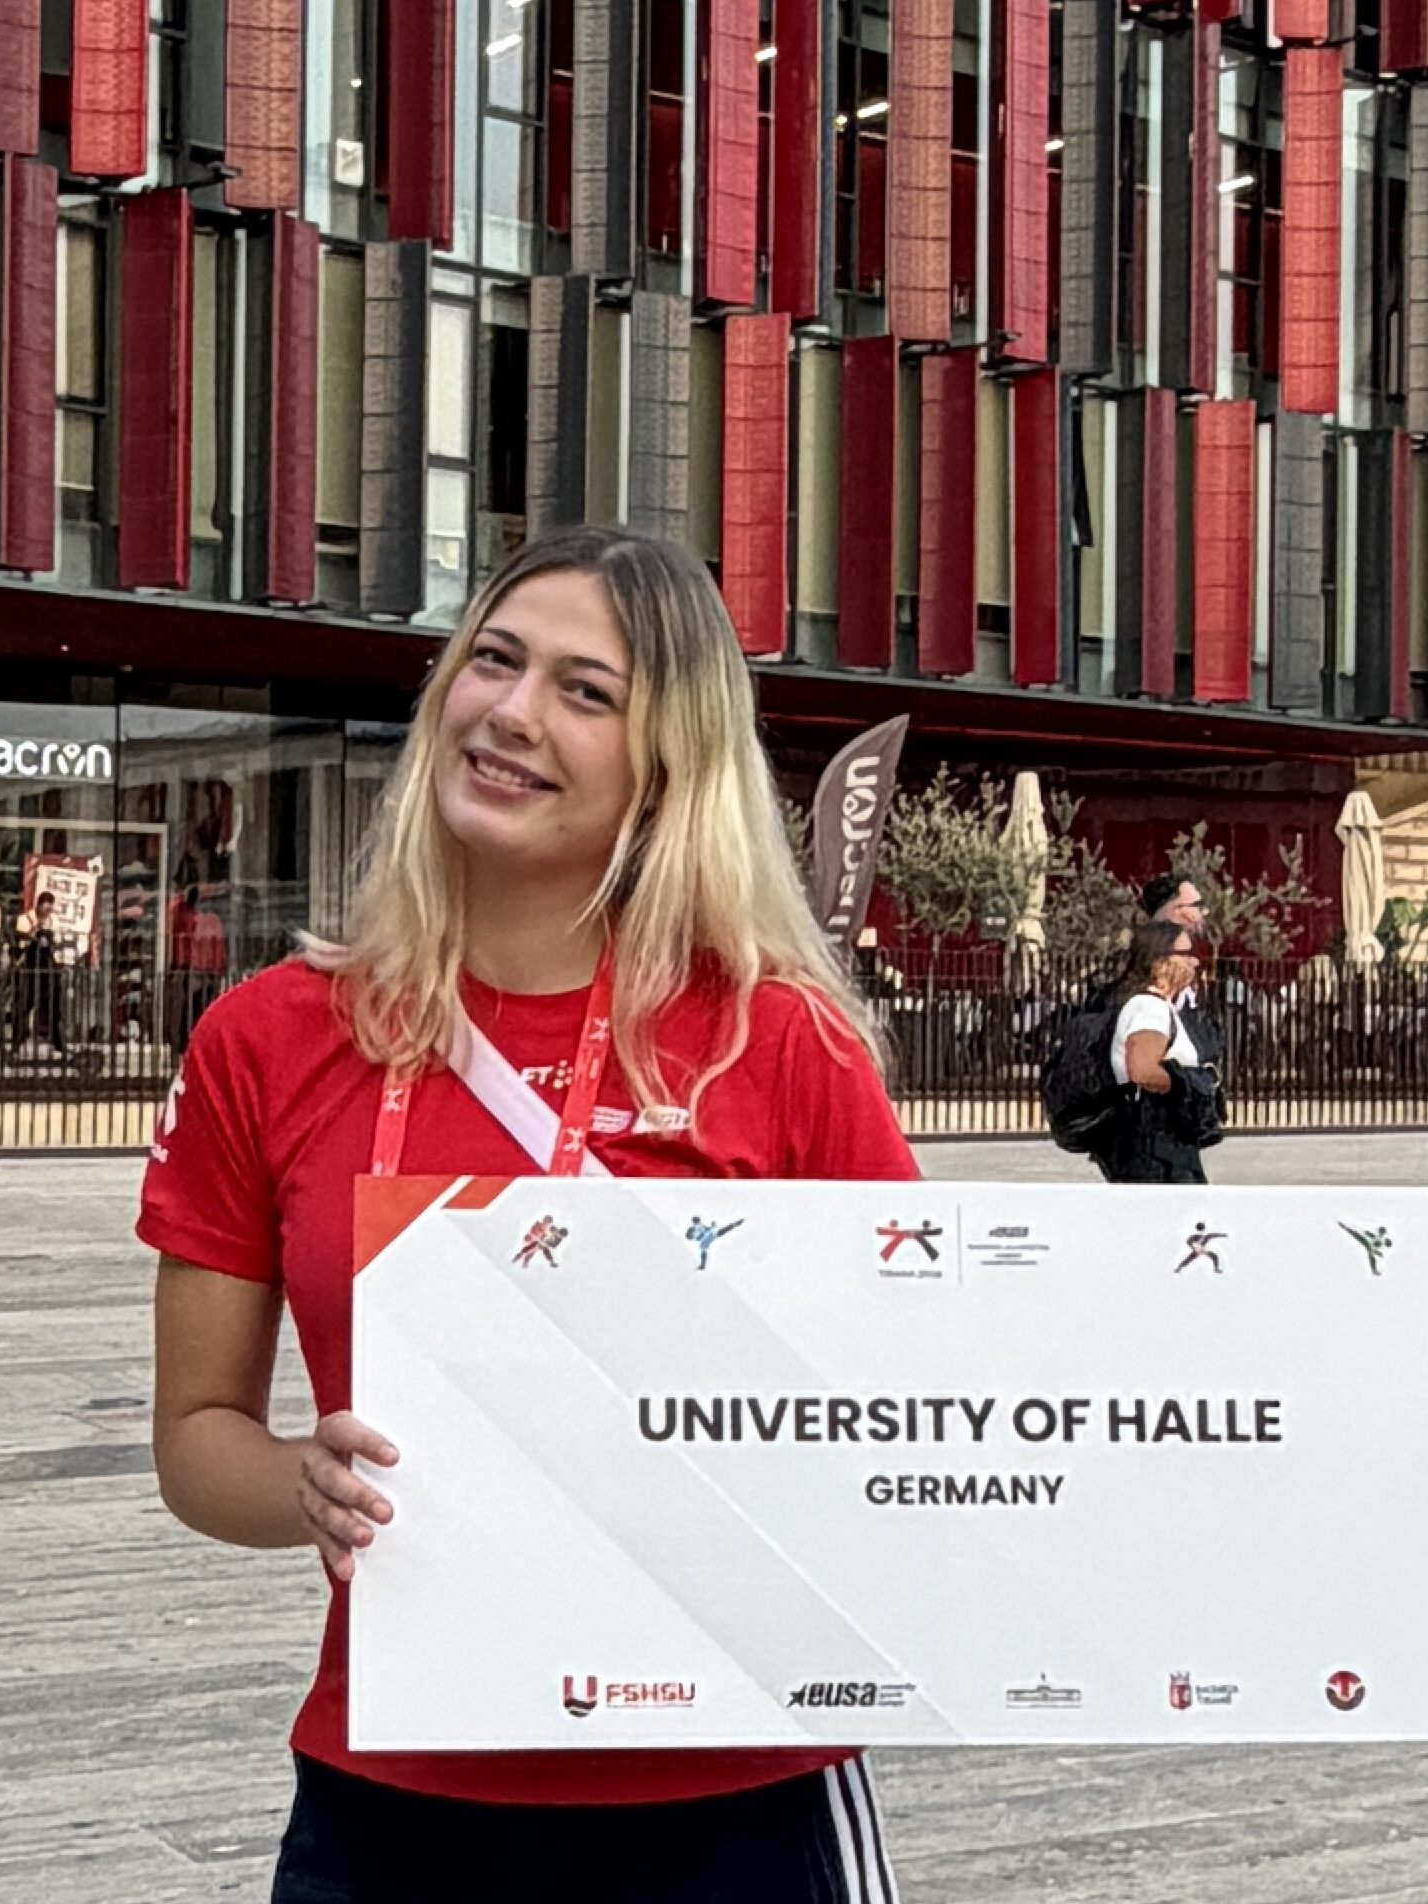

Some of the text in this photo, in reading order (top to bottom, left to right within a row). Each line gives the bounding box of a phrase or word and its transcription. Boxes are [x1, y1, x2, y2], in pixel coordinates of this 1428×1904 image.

[638, 1396, 1283, 1444] UNIVERSITY OF HALLE
[865, 1474, 1066, 1507] GERMANY
